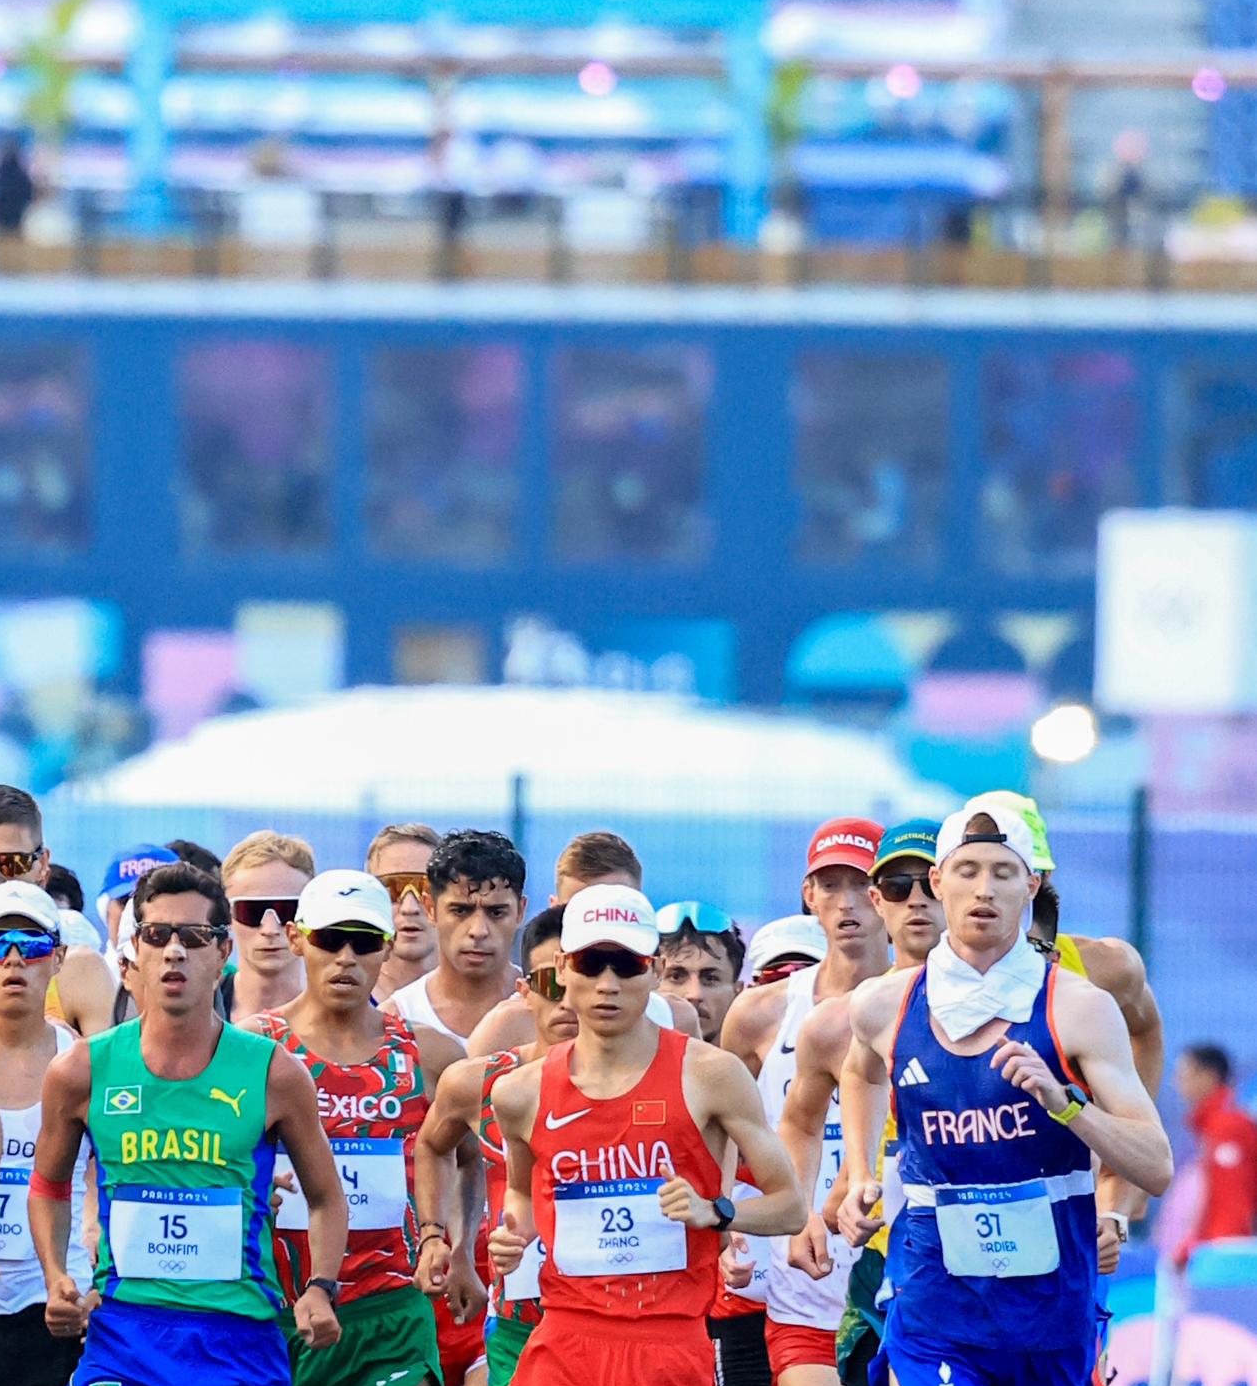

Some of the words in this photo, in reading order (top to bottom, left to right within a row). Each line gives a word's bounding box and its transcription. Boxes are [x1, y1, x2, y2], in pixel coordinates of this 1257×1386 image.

[816, 833, 875, 853] CANADA
[583, 908, 639, 924] CHINA
[317, 1088, 401, 1119] ÉXICO
[922, 1101, 1037, 1145] FRANCE
[122, 1129, 227, 1166] BRASIL
[344, 1142, 372, 1151] 2024
[551, 1140, 675, 1184] CHINA
[342, 1165, 358, 1189] 4
[584, 1184, 614, 1194] PARIS
[618, 1182, 647, 1193] 2024
[142, 1190, 173, 1200] PARIS
[178, 1192, 208, 1201] 2024
[159, 1214, 187, 1239] 15
[600, 1207, 634, 1233] 23
[974, 1213, 1002, 1238] 37
[148, 1242, 198, 1255] BONFIM
[598, 1235, 639, 1249] ZHANG
